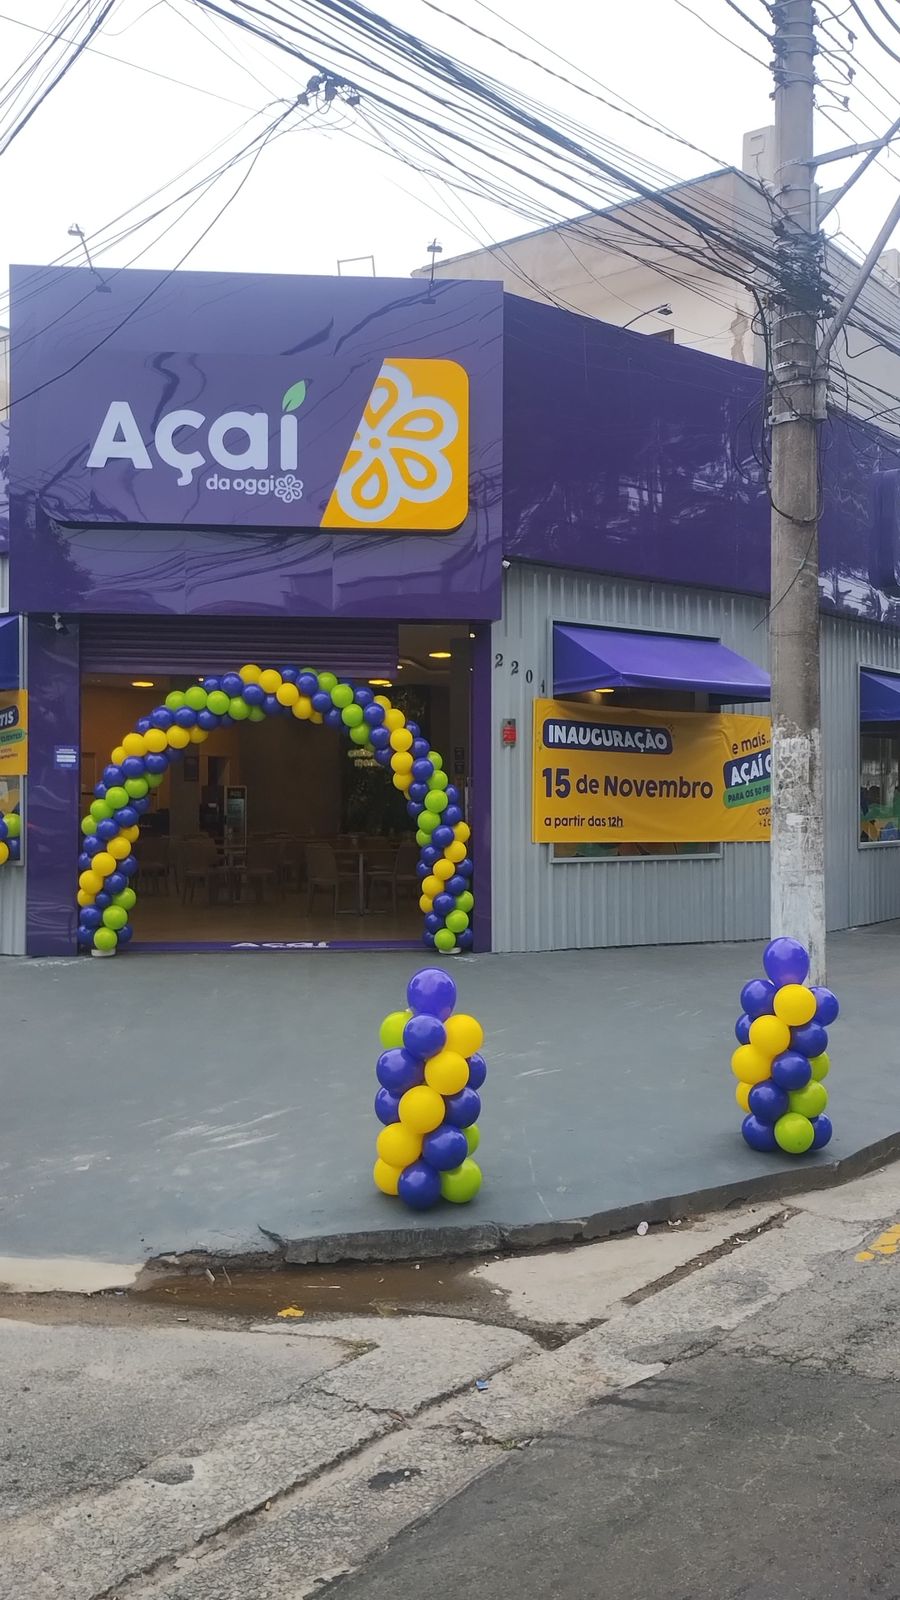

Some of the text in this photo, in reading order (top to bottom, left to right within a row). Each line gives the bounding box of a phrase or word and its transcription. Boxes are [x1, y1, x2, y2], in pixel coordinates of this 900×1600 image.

[206, 474, 274, 495] da oggi
[548, 724, 668, 752] INAUGURAÇÃO
[732, 743, 739, 755] e
[731, 753, 764, 786] AÇAÍ
[542, 767, 713, 798] 15 de Novembro
[727, 792, 744, 803] PARA
[746, 790, 754, 798] OS
[544, 815, 623, 829] a partir das 12h
